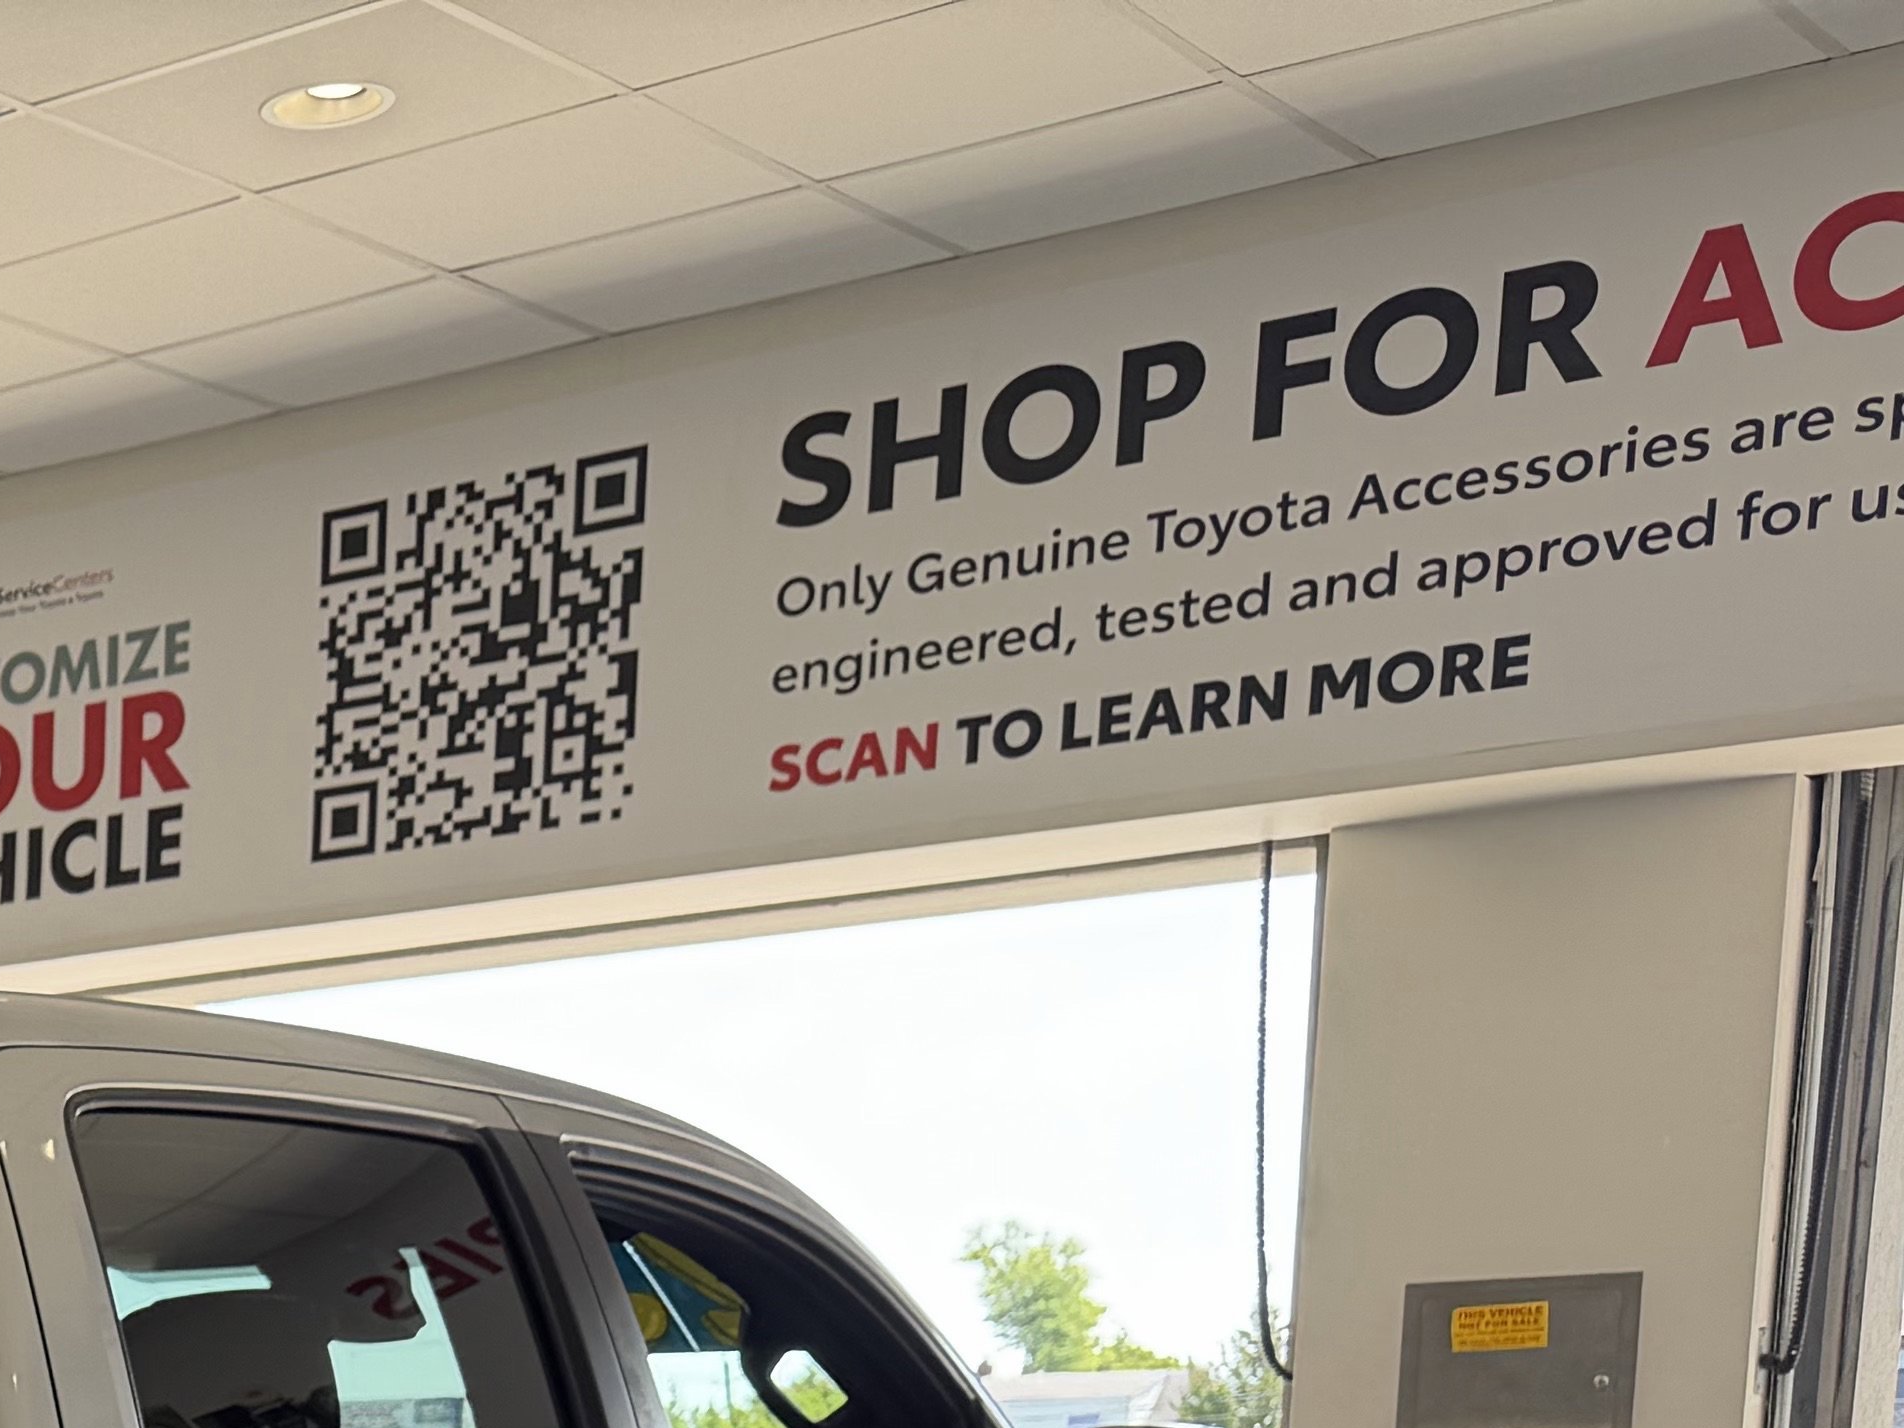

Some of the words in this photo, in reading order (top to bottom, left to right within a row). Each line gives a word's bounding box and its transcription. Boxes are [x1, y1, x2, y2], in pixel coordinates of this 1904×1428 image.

[777, 341, 1206, 530] SHOP
[1253, 261, 1602, 441] FOR
[1646, 191, 1904, 368] AC
[773, 608, 1076, 694] engineered,
[1096, 571, 1270, 641] tested
[1289, 551, 1398, 611] and
[1417, 499, 1717, 598] approved
[1737, 491, 1832, 540] for
[778, 564, 892, 616] Only
[908, 529, 1129, 593] Genuine
[1147, 492, 1329, 556] Toyota
[1348, 425, 1714, 524] Accessories
[1731, 407, 1834, 453] are
[770, 723, 938, 791] SCAN
[957, 710, 1042, 764] TO
[1061, 670, 1287, 750] LEARN
[1309, 634, 1530, 715] MORE
[1489, 1305, 1544, 1319] VEHICLE
